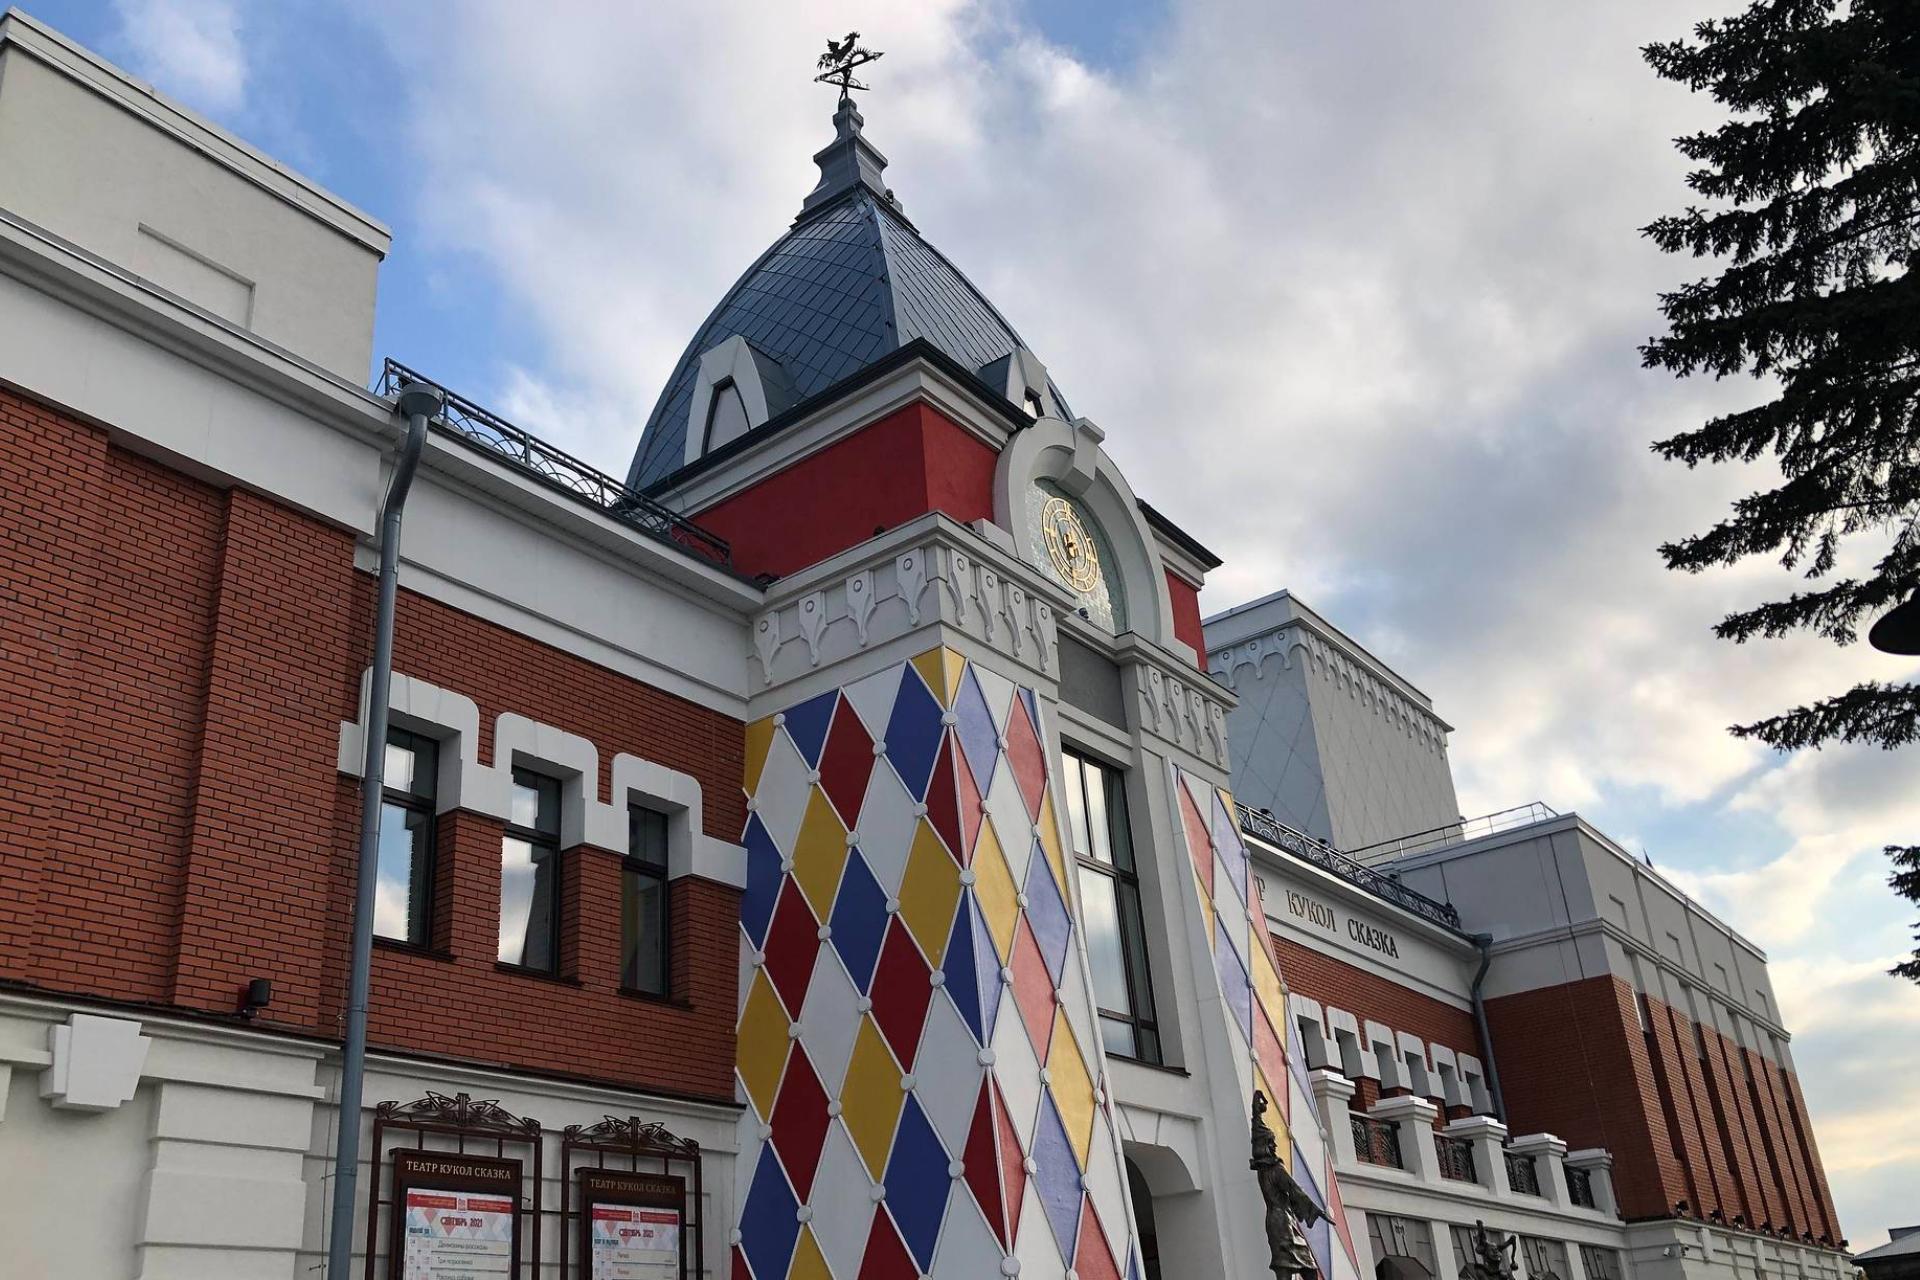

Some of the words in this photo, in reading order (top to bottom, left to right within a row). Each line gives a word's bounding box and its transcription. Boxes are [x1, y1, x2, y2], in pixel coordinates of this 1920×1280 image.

[1286, 890, 1337, 933] КУКОЛ
[1347, 918, 1400, 960] СКАЗКА
[406, 1161, 438, 1173] ТЕАТР
[440, 1164, 472, 1177] КУКОЛ
[474, 1168, 511, 1180] СКАЗКА
[590, 1178, 616, 1189] ТЕАТР
[617, 1181, 645, 1192] КУКОЛ
[645, 1184, 676, 1195] СКАЗКА
[469, 1218, 483, 1228] 2021
